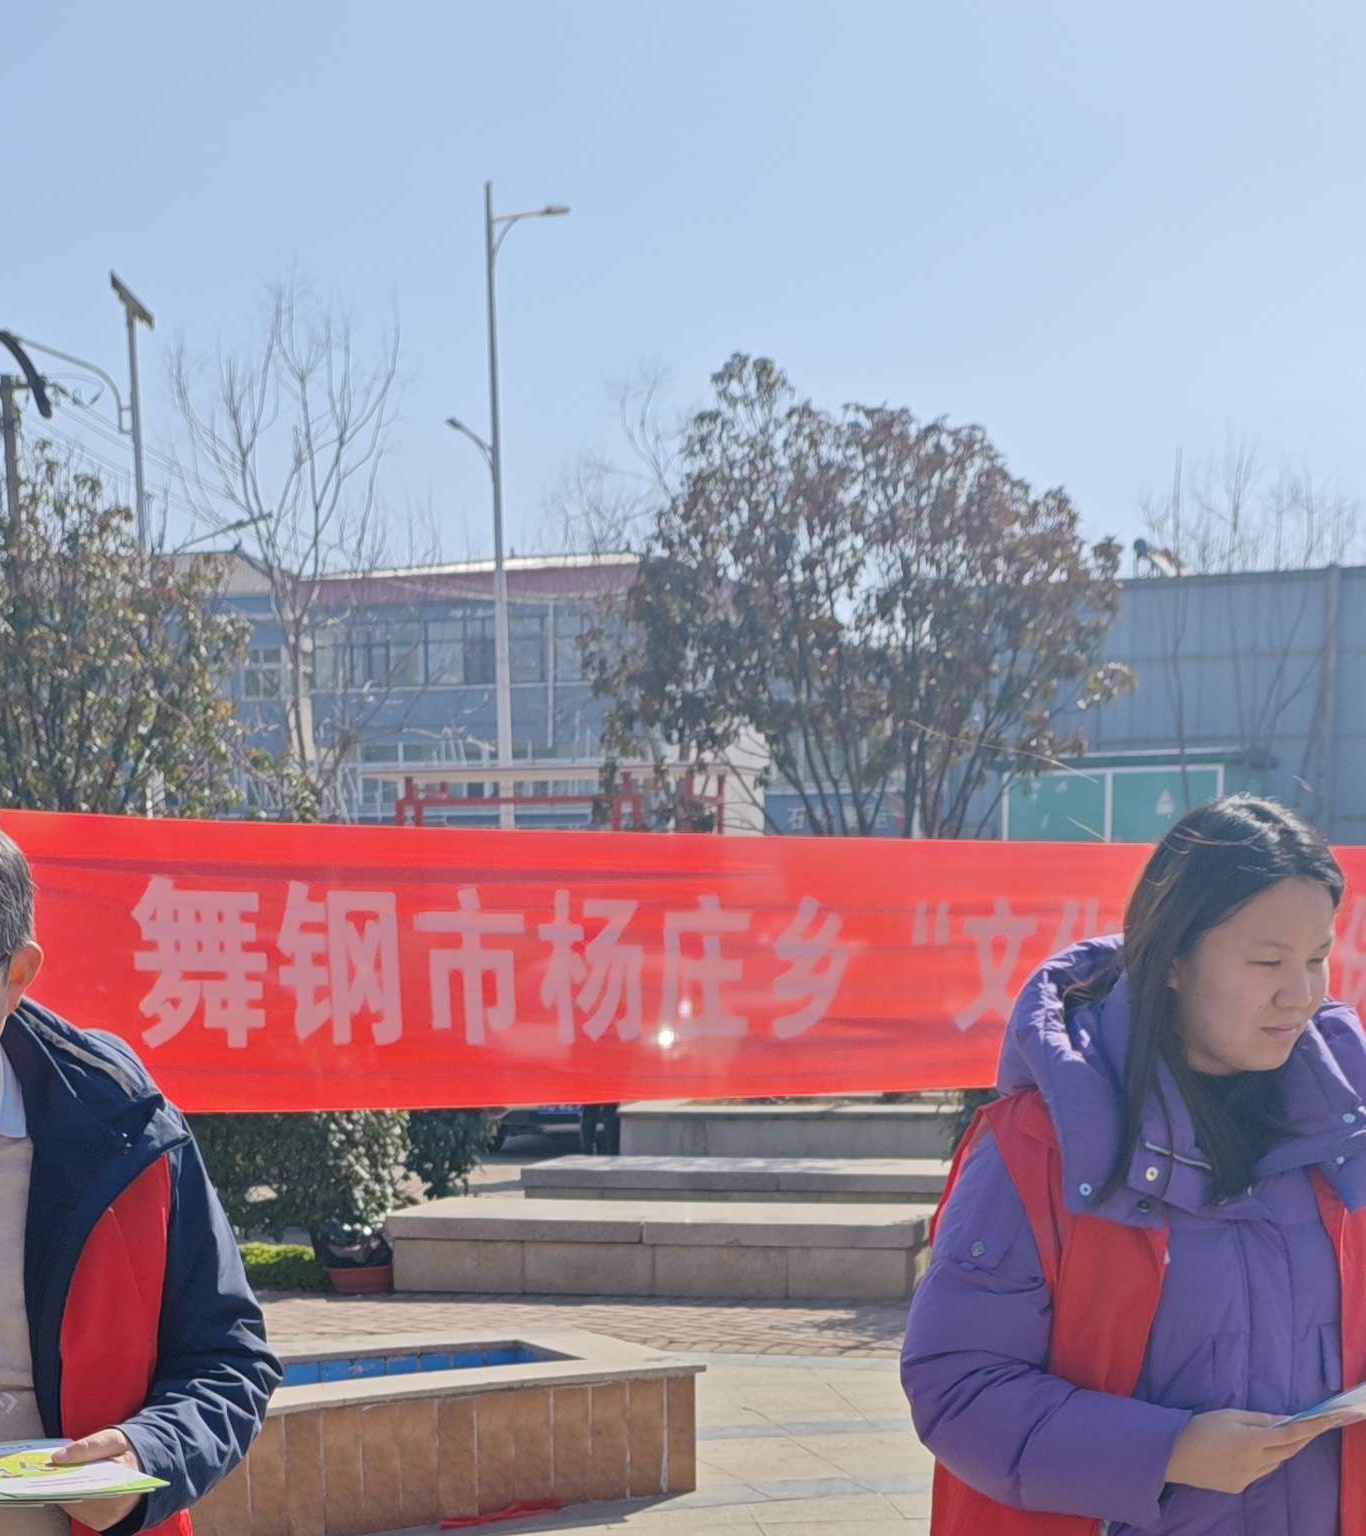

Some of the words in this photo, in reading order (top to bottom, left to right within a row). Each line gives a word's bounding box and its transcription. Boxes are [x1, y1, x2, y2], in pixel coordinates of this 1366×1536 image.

[130, 876, 850, 1049] 舞钢市杨庄乡
